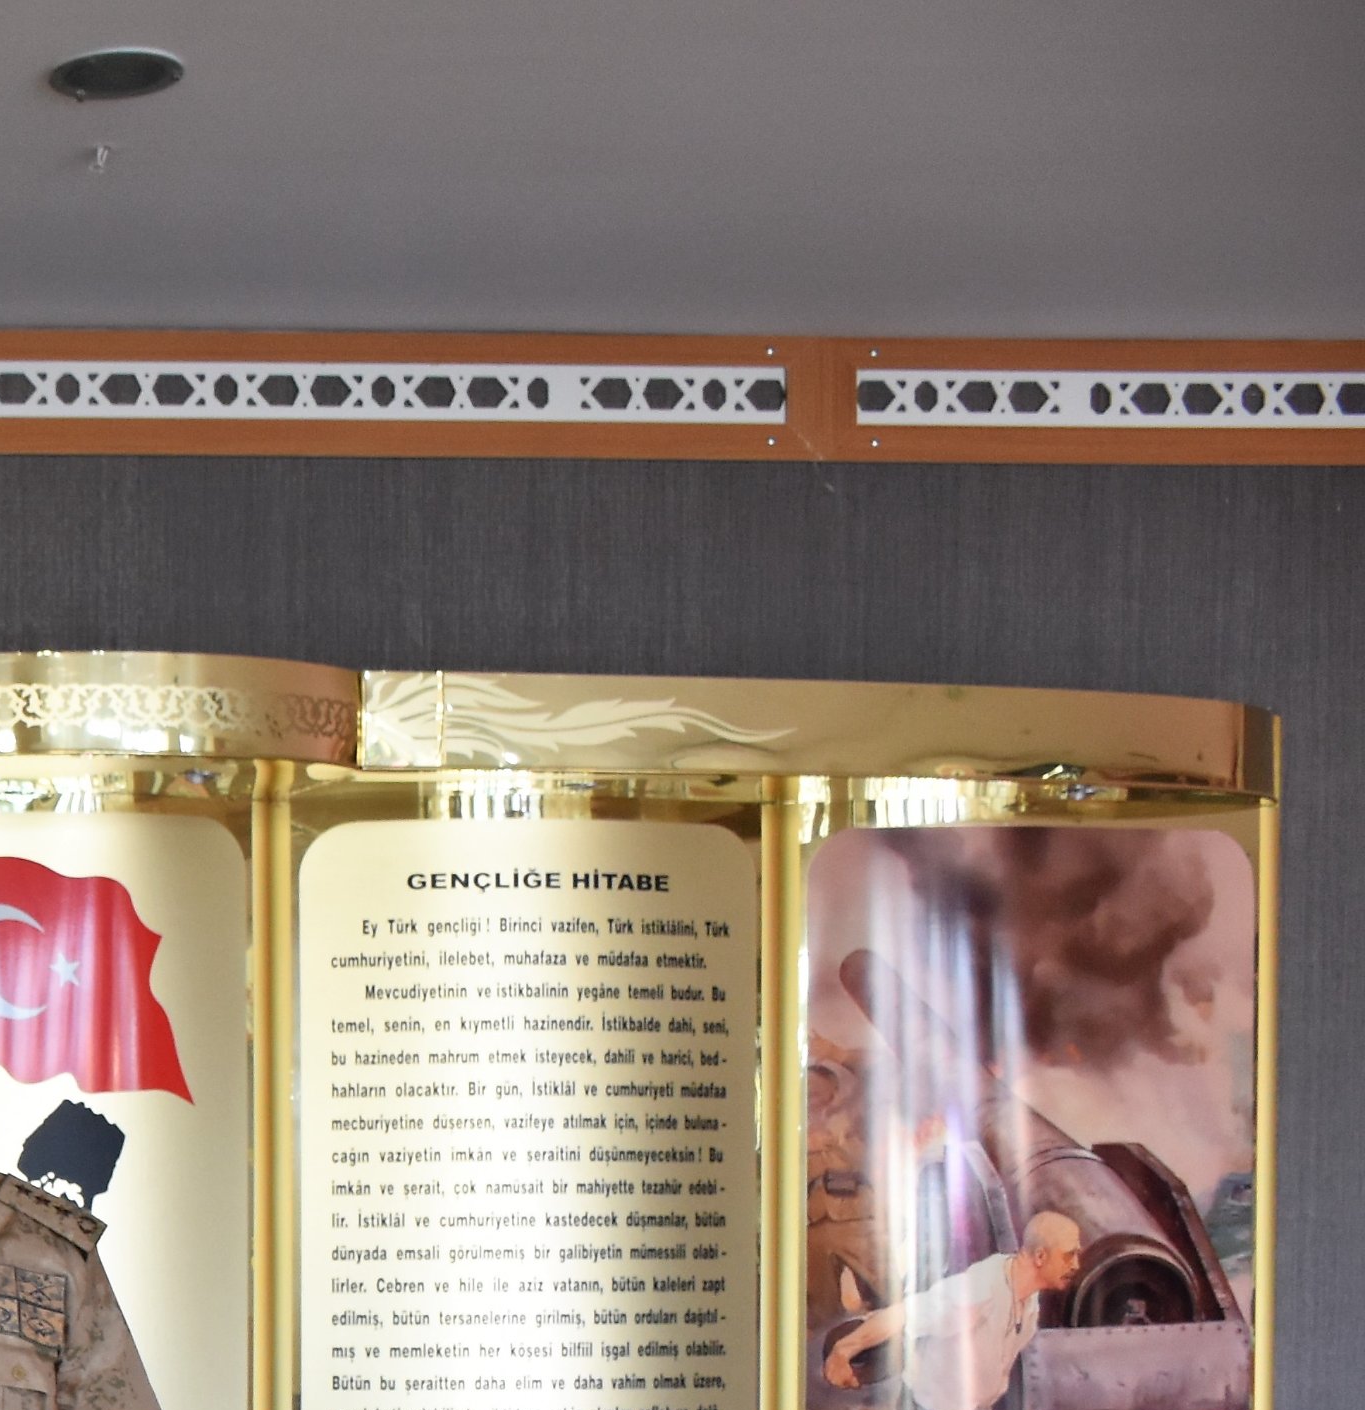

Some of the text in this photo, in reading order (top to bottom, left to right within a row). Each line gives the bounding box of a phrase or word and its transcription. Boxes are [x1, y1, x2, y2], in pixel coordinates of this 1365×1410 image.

[407, 867, 669, 893] GENÇLİĞE HİTABE
[362, 919, 377, 938] Ey
[499, 916, 541, 932] Birinci
[503, 949, 566, 965] muhafaza
[365, 982, 568, 1002] Mevcudiyetinin istikbalinin
[523, 1015, 593, 1031] hazinendir.
[354, 1049, 419, 1065] hazineden
[428, 1049, 479, 1064] mahrum
[331, 1082, 386, 1098] hahların
[395, 1081, 458, 1097] olacaktır.
[503, 1113, 554, 1132] vazifeye
[562, 1113, 607, 1129] atılmak
[379, 1146, 441, 1165] vaziyetin
[576, 1178, 635, 1197] mahiyette
[331, 1211, 618, 1228] lir. kastedecek
[396, 1244, 439, 1260] emsali
[331, 1277, 367, 1293] lirler.
[376, 1277, 424, 1293] Cebren
[331, 1341, 630, 1362] mış memleketin işgal
